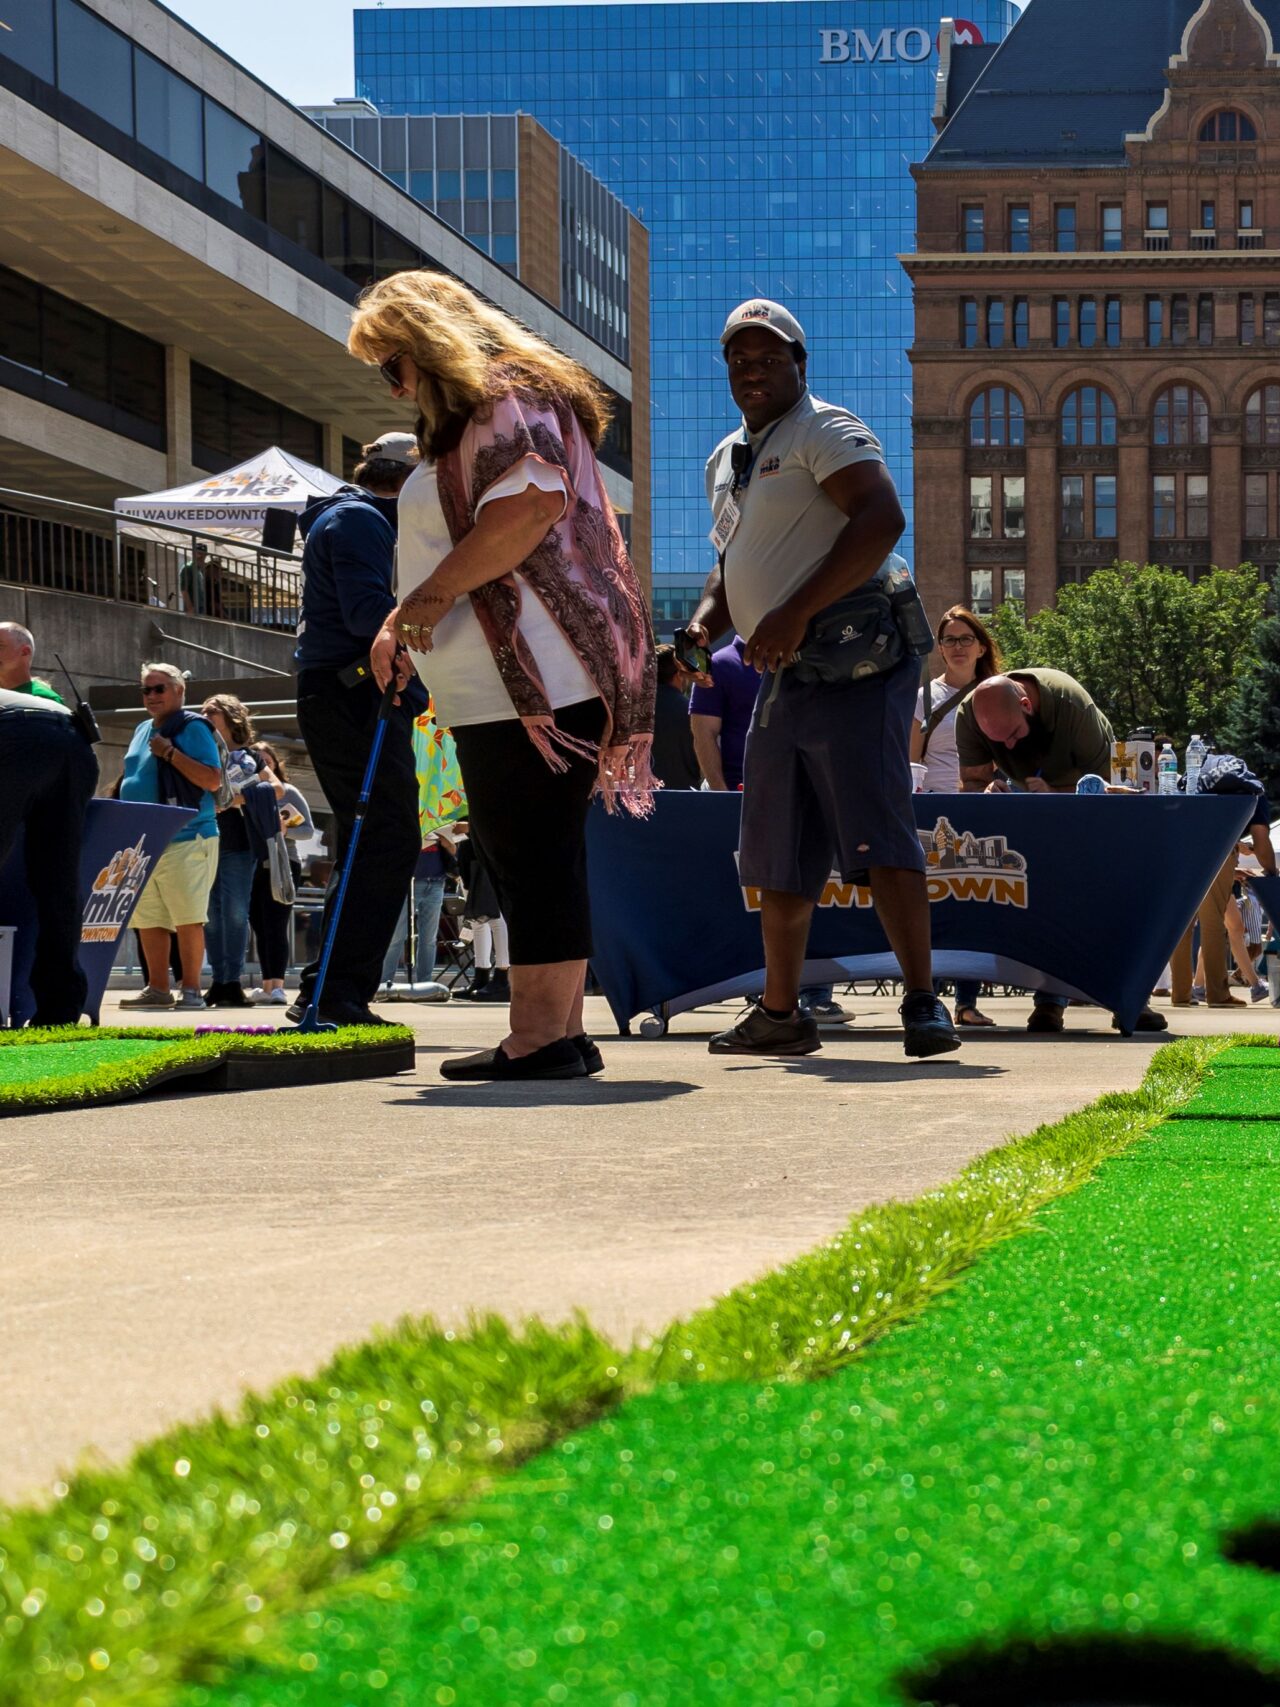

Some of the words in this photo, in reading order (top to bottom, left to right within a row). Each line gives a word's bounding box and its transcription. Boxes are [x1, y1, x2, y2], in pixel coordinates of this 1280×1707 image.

[818, 27, 932, 64] BMO
[193, 479, 291, 498] mke
[118, 508, 297, 521] IWAUKEEDOWNT
[82, 876, 135, 923] mke
[745, 877, 1026, 907] WOWN
